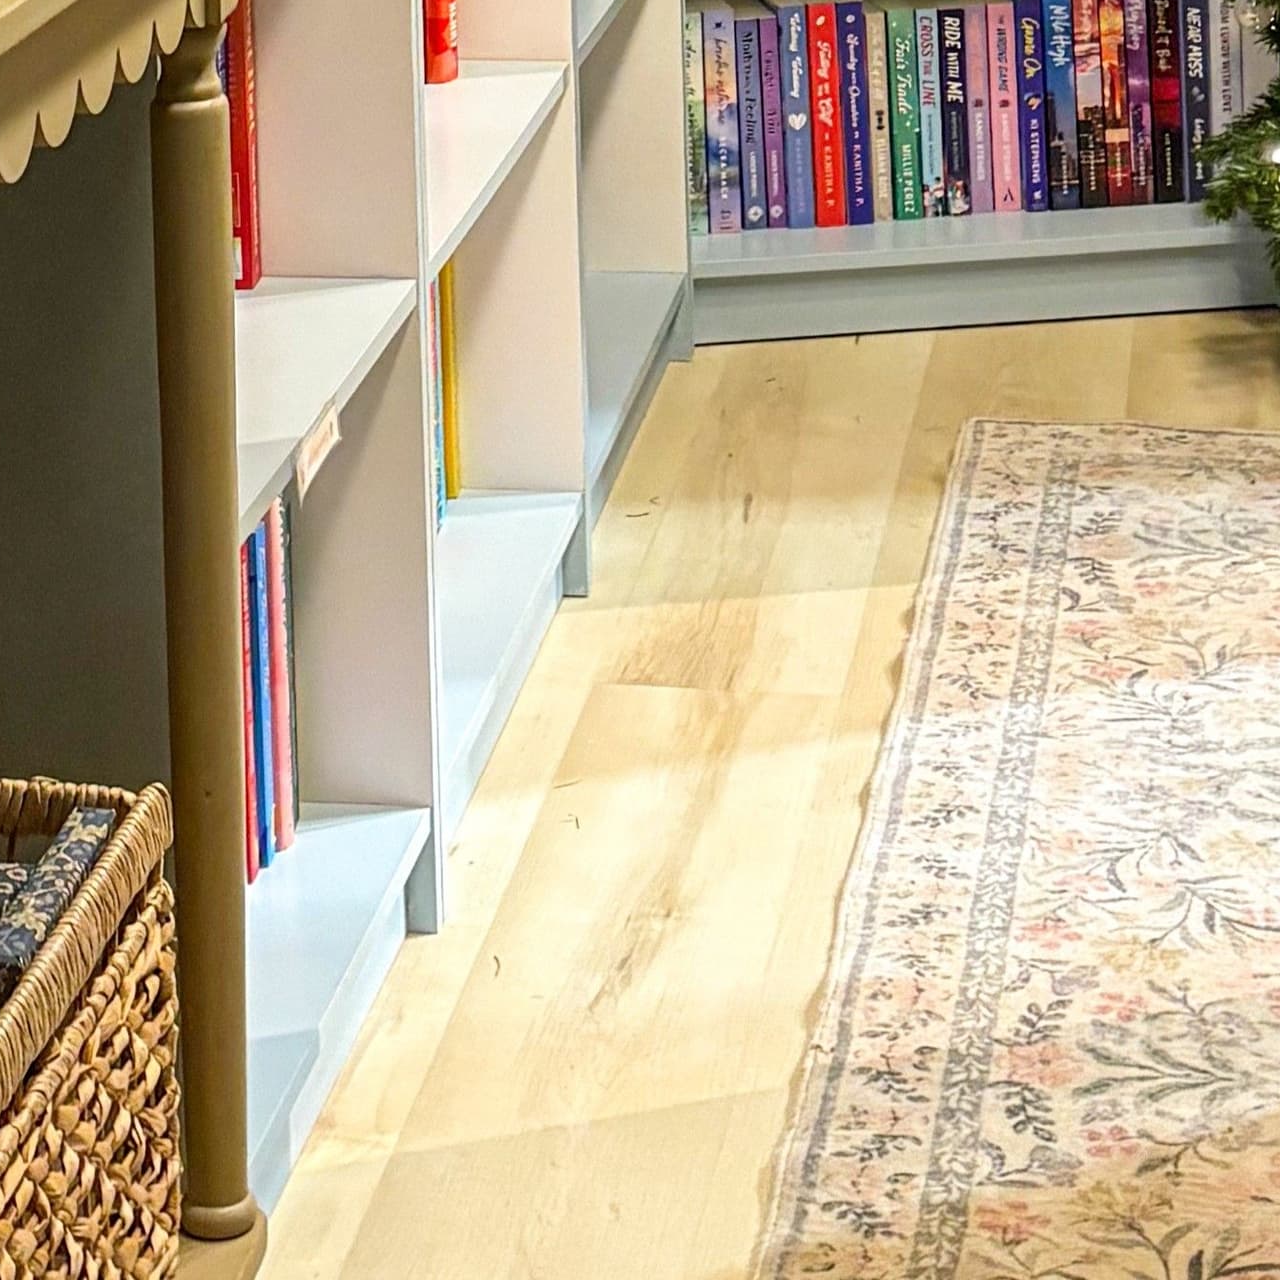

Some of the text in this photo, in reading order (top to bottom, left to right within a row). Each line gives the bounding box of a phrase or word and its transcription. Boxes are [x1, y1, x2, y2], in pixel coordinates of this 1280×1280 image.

[1186, 7, 1202, 41] NEAR
[919, 16, 936, 107] CROSS LINE
[943, 16, 963, 103] RIDE WITH ME
[897, 73, 913, 116] Trade
[903, 180, 915, 213] PEREZ
